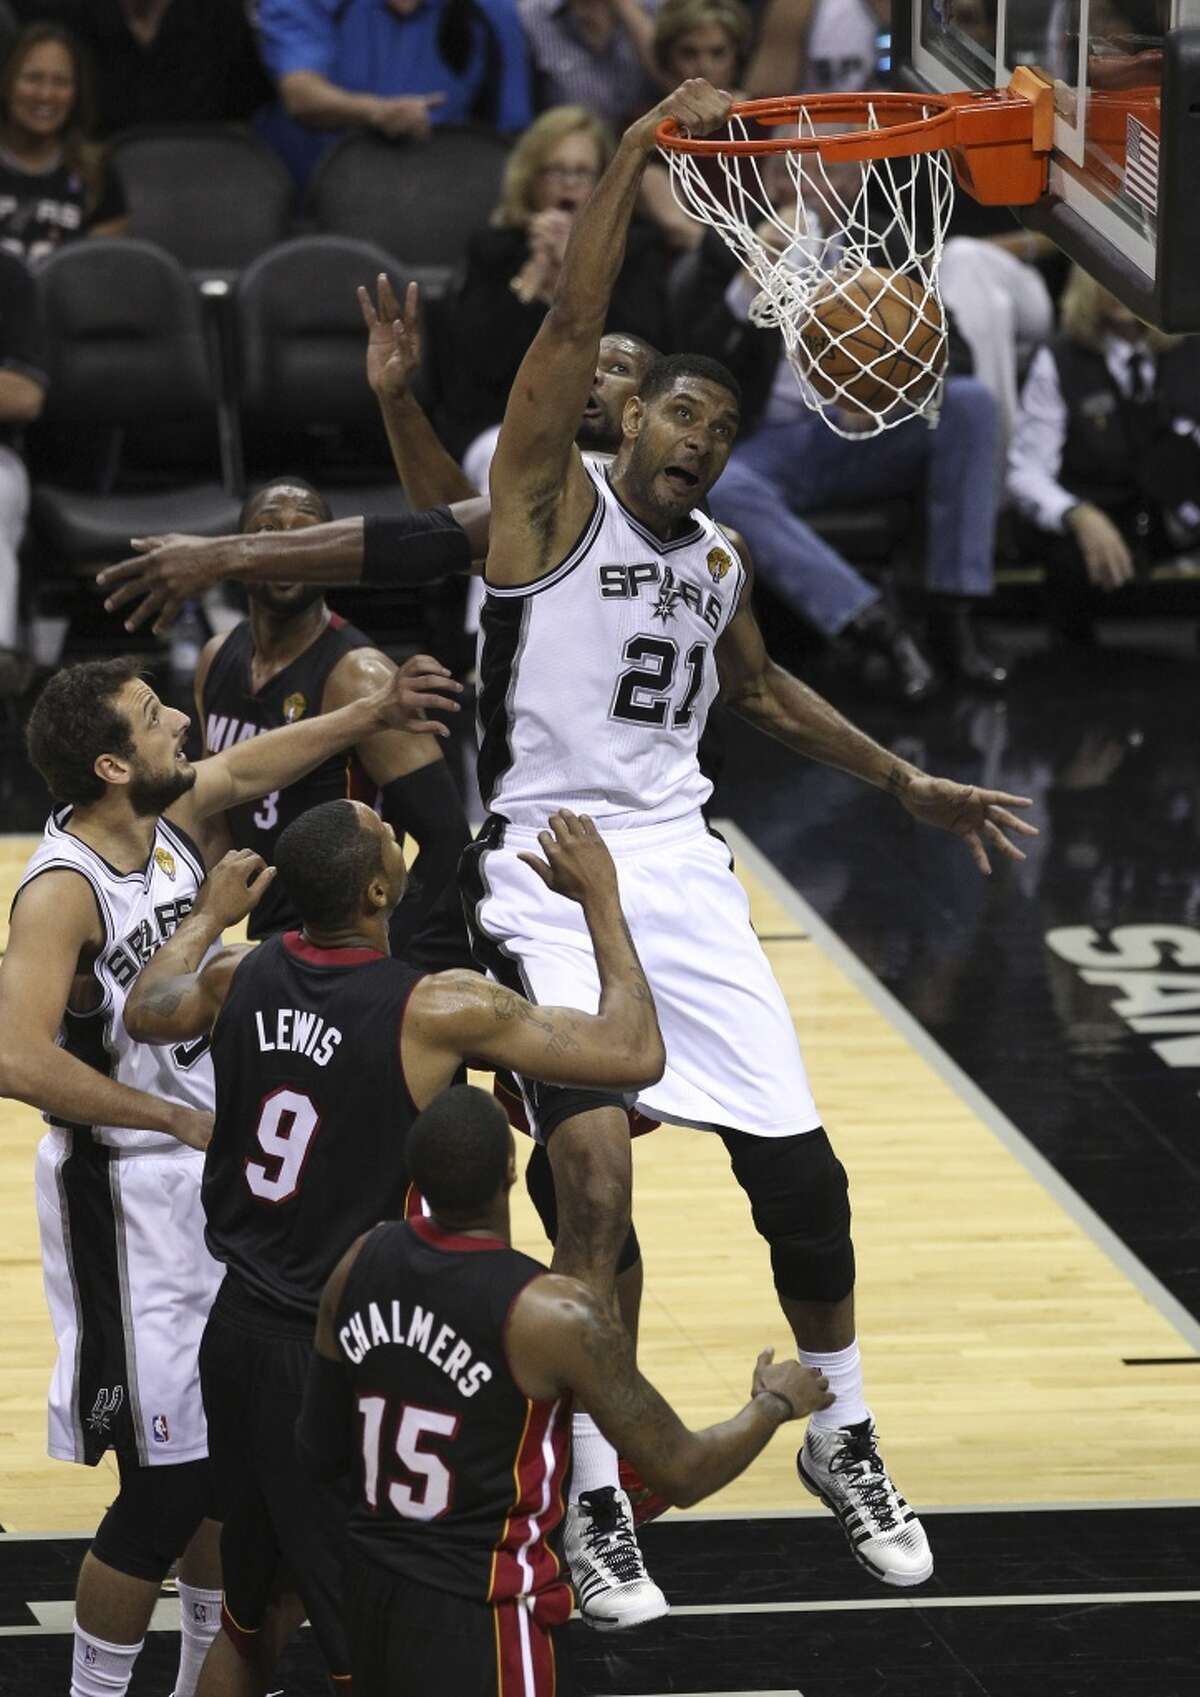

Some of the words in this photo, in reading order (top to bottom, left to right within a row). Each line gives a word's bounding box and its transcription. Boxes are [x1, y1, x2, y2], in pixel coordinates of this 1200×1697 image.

[598, 561, 723, 633] SPURS
[607, 632, 709, 730] 21
[206, 713, 270, 753] MIA
[253, 790, 280, 830] 3
[255, 1008, 343, 1067] LEWIS
[245, 1087, 322, 1204] 9
[338, 1299, 493, 1398] CHALMERS
[356, 1395, 459, 1523] 15
